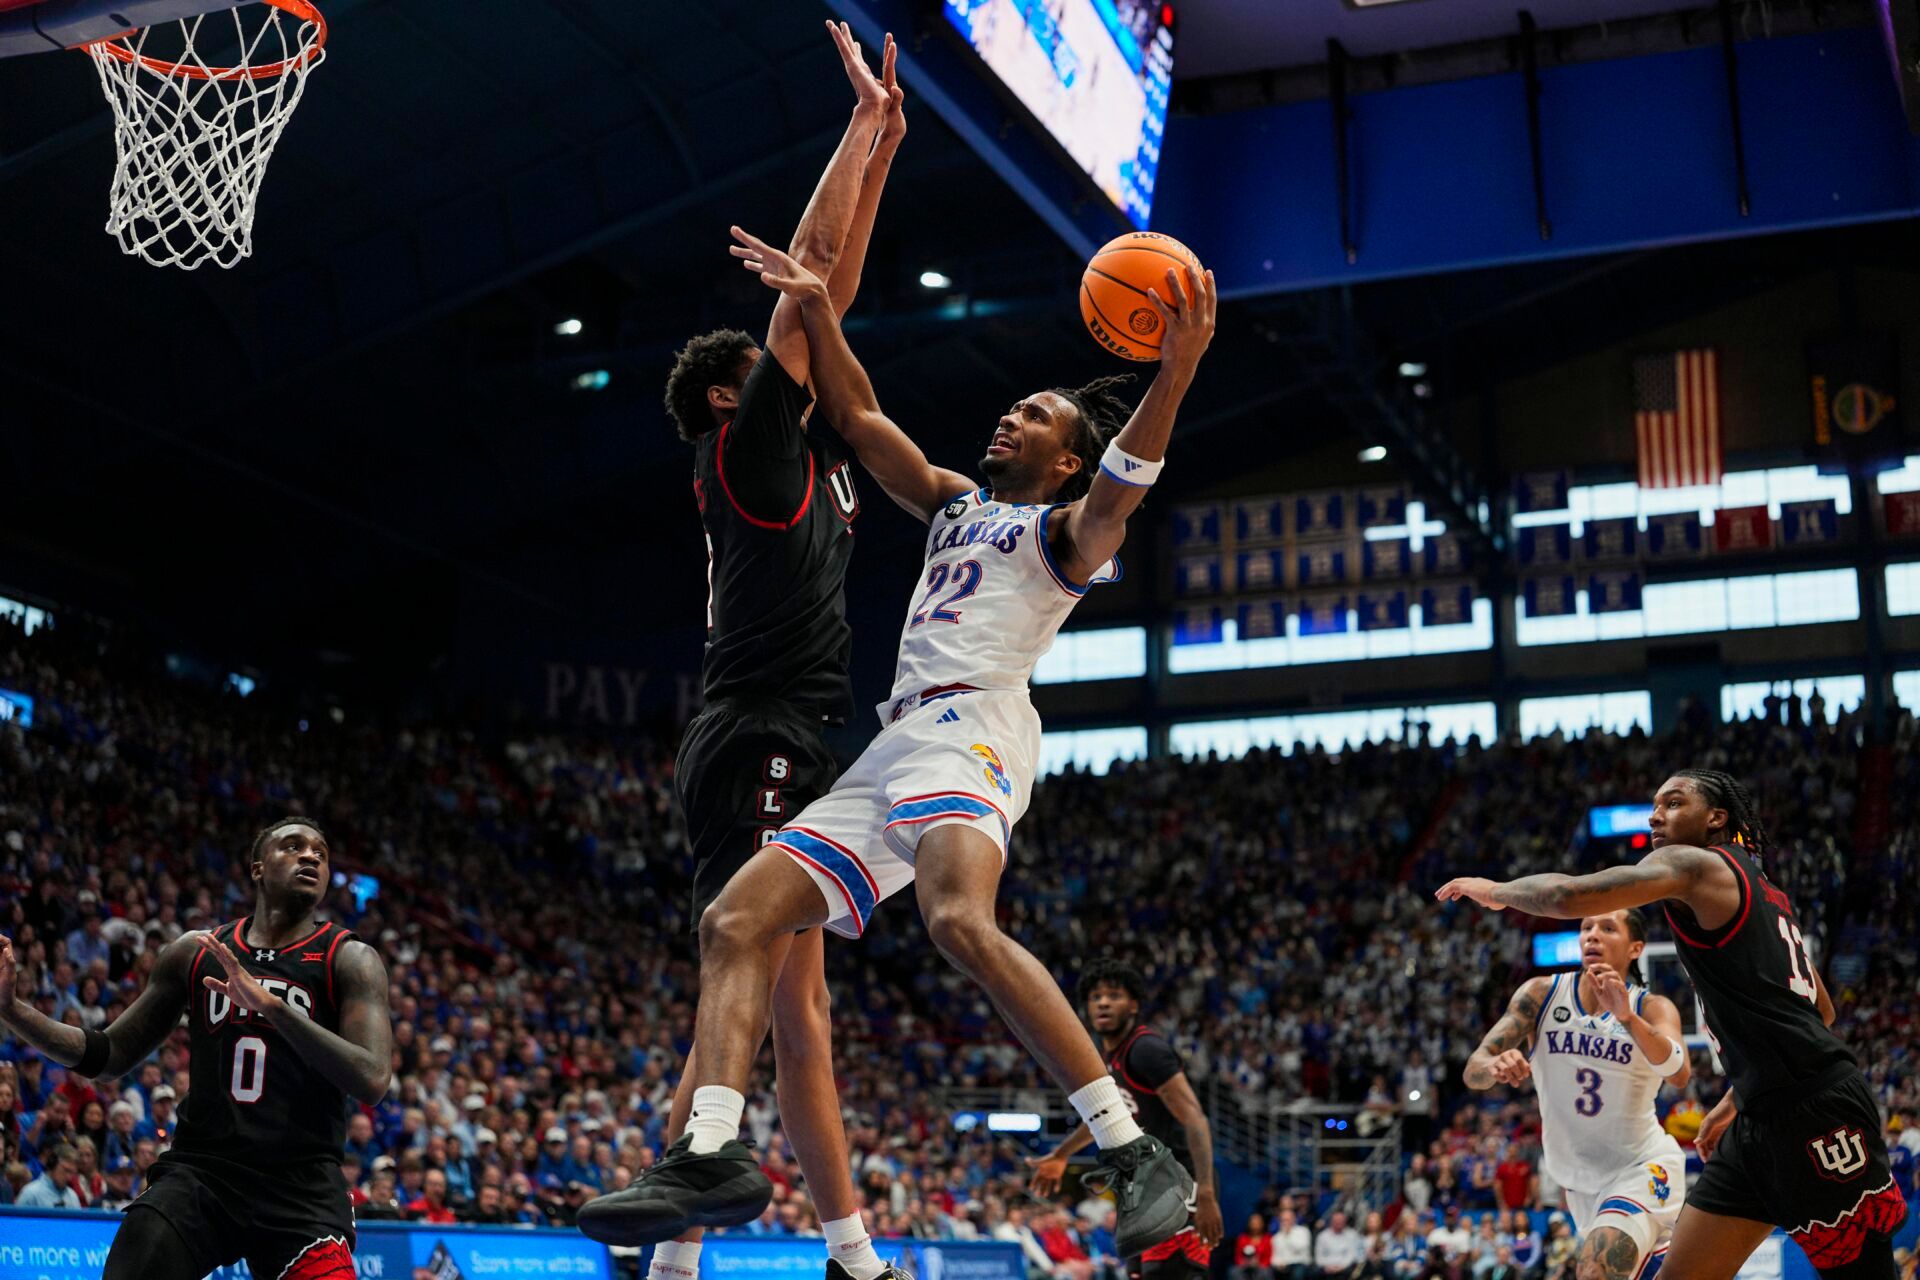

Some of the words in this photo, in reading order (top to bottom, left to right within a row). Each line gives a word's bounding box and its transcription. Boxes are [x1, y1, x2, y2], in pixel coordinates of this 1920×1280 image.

[829, 462, 856, 514] U
[946, 501, 967, 515] SW
[928, 520, 1026, 560] KANSAS
[909, 559, 983, 630] 22
[541, 661, 649, 727] PAY
[230, 1035, 267, 1103] 0
[1545, 1030, 1634, 1065] KANSAS
[1575, 1067, 1604, 1117] 3
[0, 1245, 24, 1266] re
[29, 1246, 80, 1267] more
